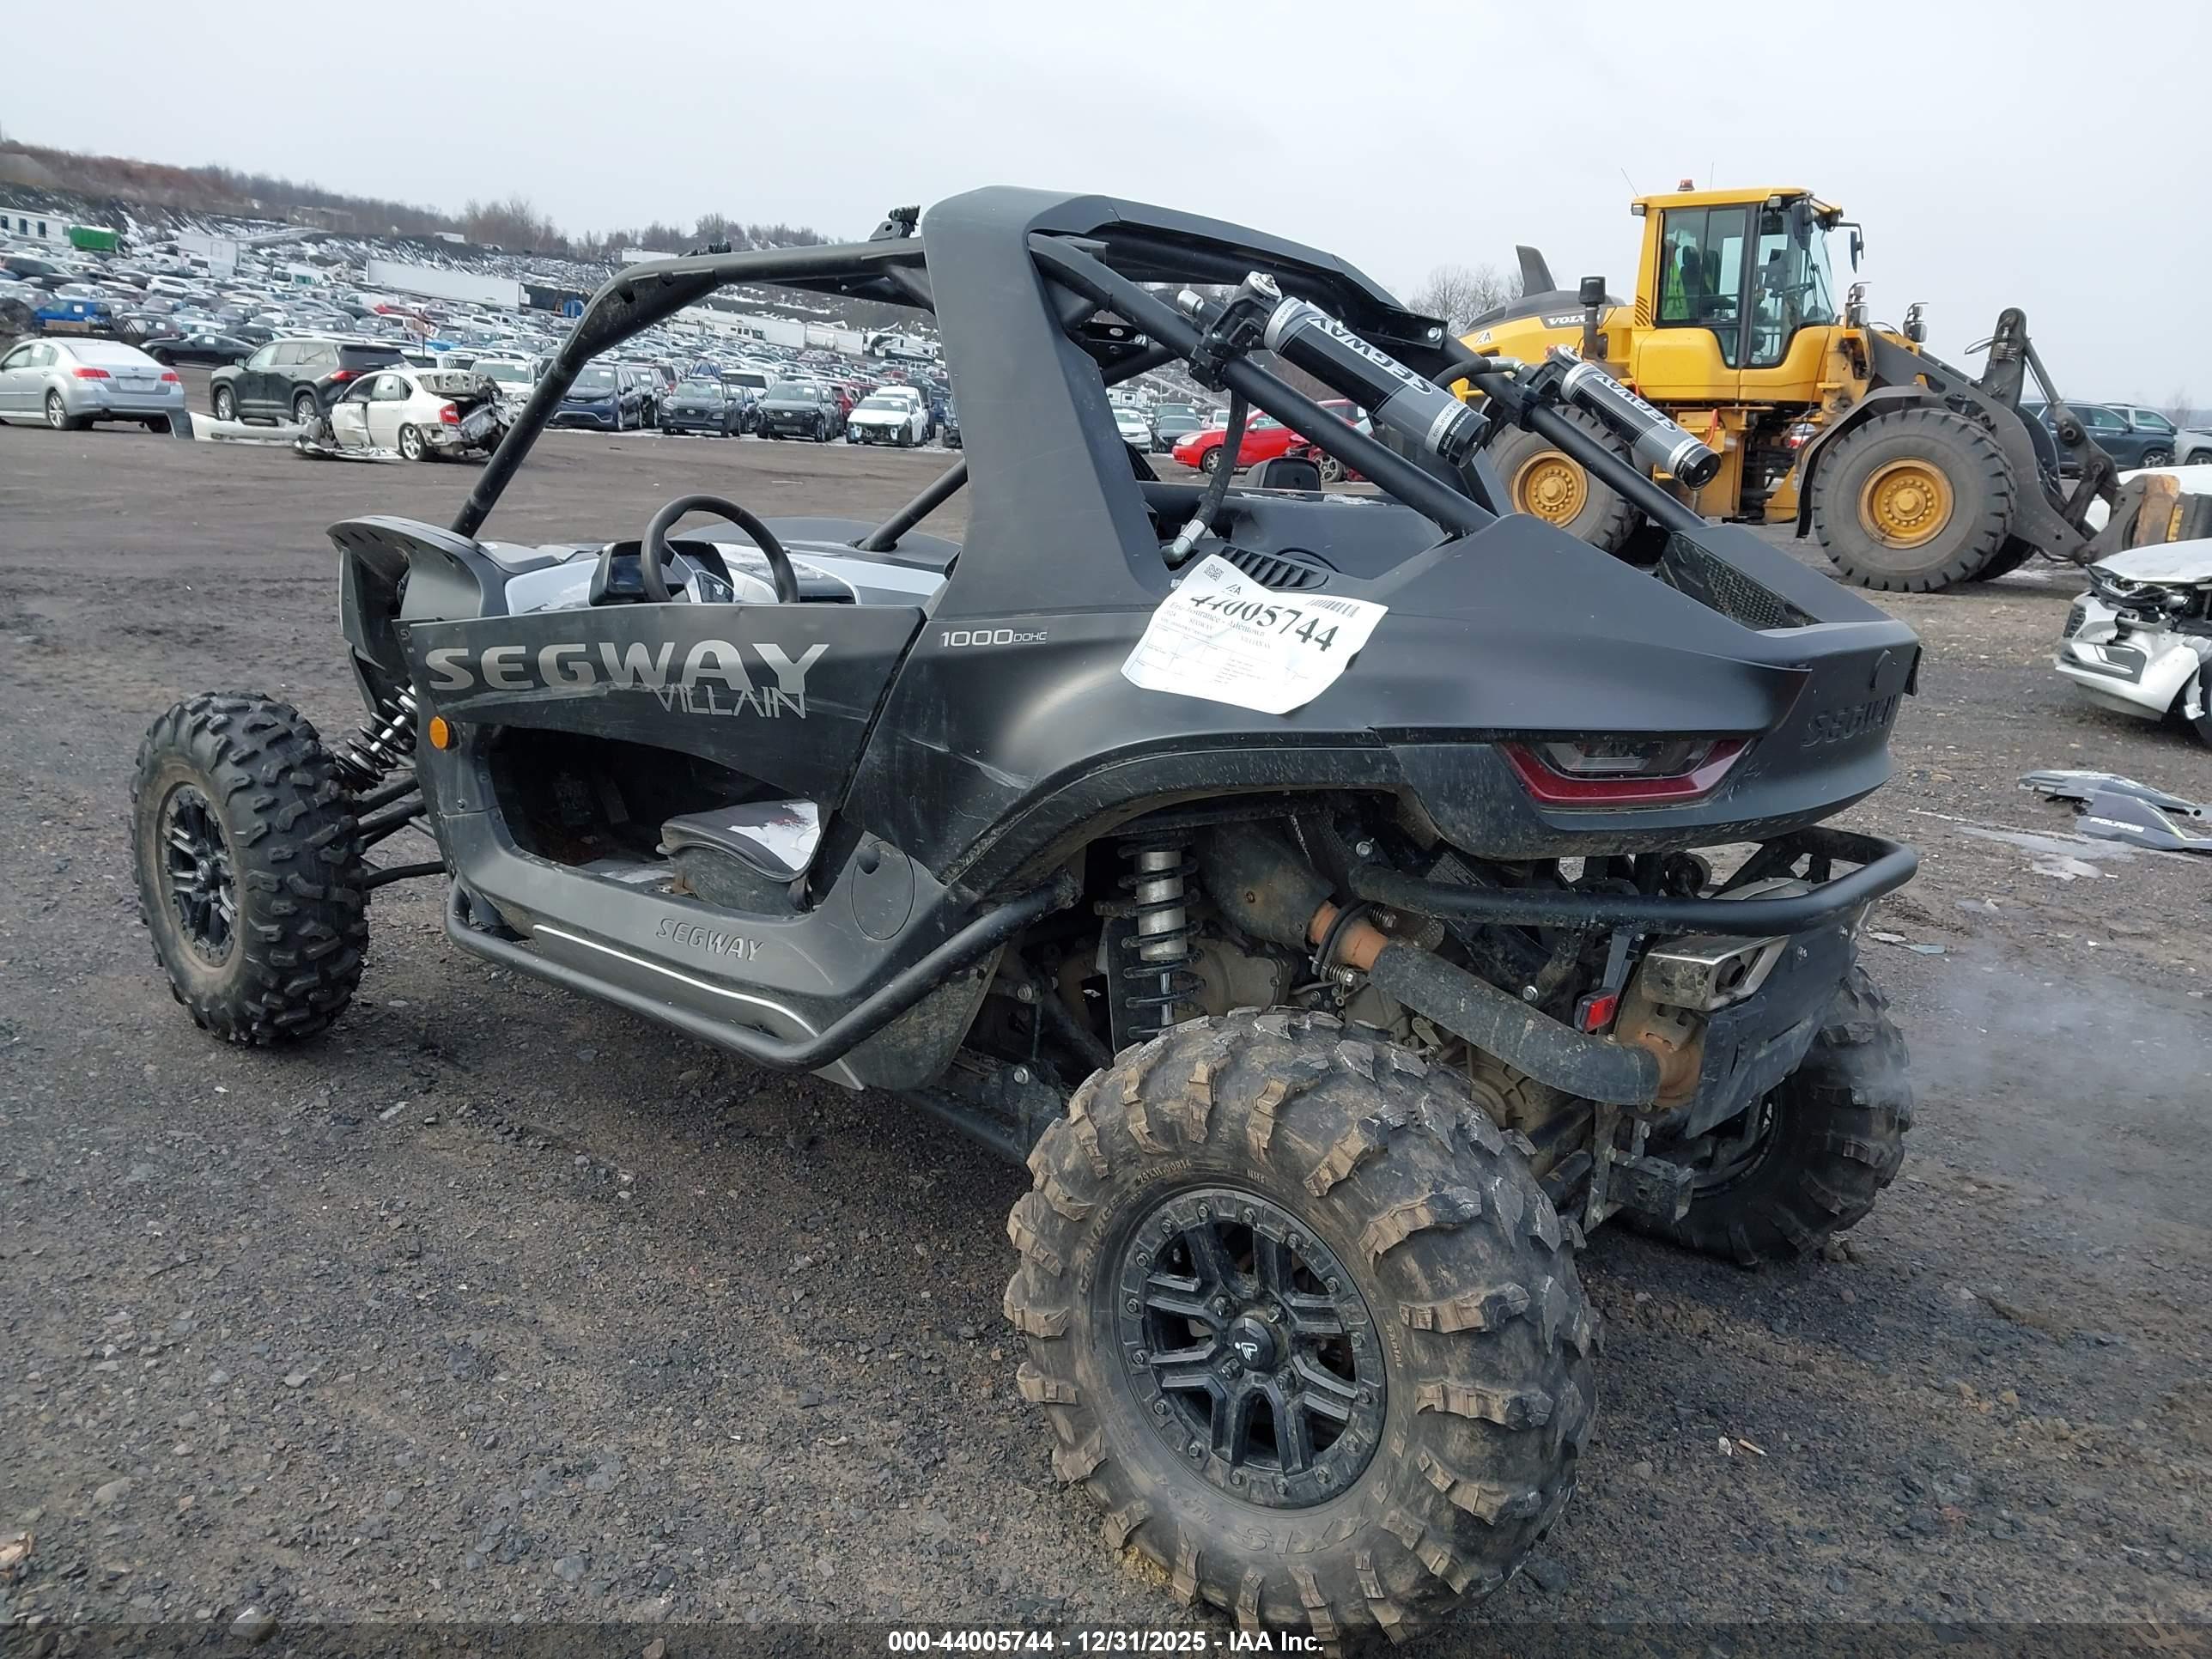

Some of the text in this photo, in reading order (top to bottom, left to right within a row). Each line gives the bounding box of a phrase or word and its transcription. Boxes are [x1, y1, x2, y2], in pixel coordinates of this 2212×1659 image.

[1307, 315, 1437, 395] SEGWAY
[1594, 374, 1678, 432] SEGWAY
[1190, 595, 1340, 653] 44005744
[424, 639, 831, 692] SEGWAY
[653, 682, 807, 720] VILLAIN
[2090, 817, 2145, 833] POLARIS
[655, 918, 763, 962] SEGWAY
